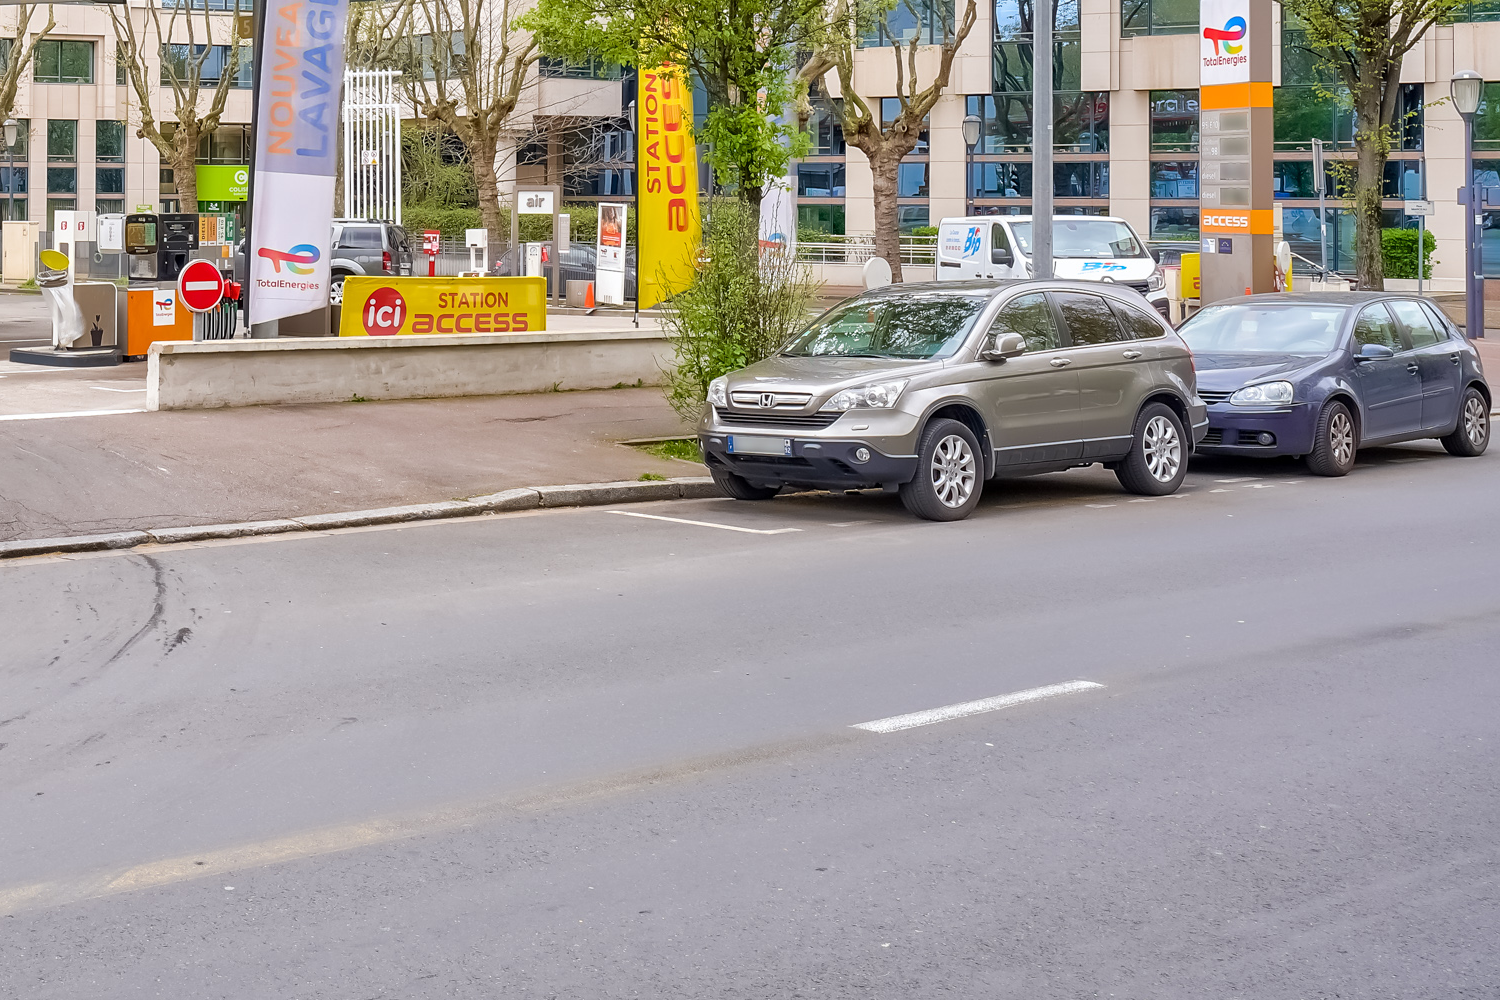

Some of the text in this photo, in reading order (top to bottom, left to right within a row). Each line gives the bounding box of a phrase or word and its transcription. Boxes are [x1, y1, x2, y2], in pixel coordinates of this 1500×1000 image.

[1202, 54, 1247, 67] TotalEnergies
[644, 73, 662, 194] STATION
[526, 194, 546, 208] air
[256, 279, 320, 292] TotalEnergies
[438, 292, 509, 309] STATION
[367, 298, 402, 328] ici
